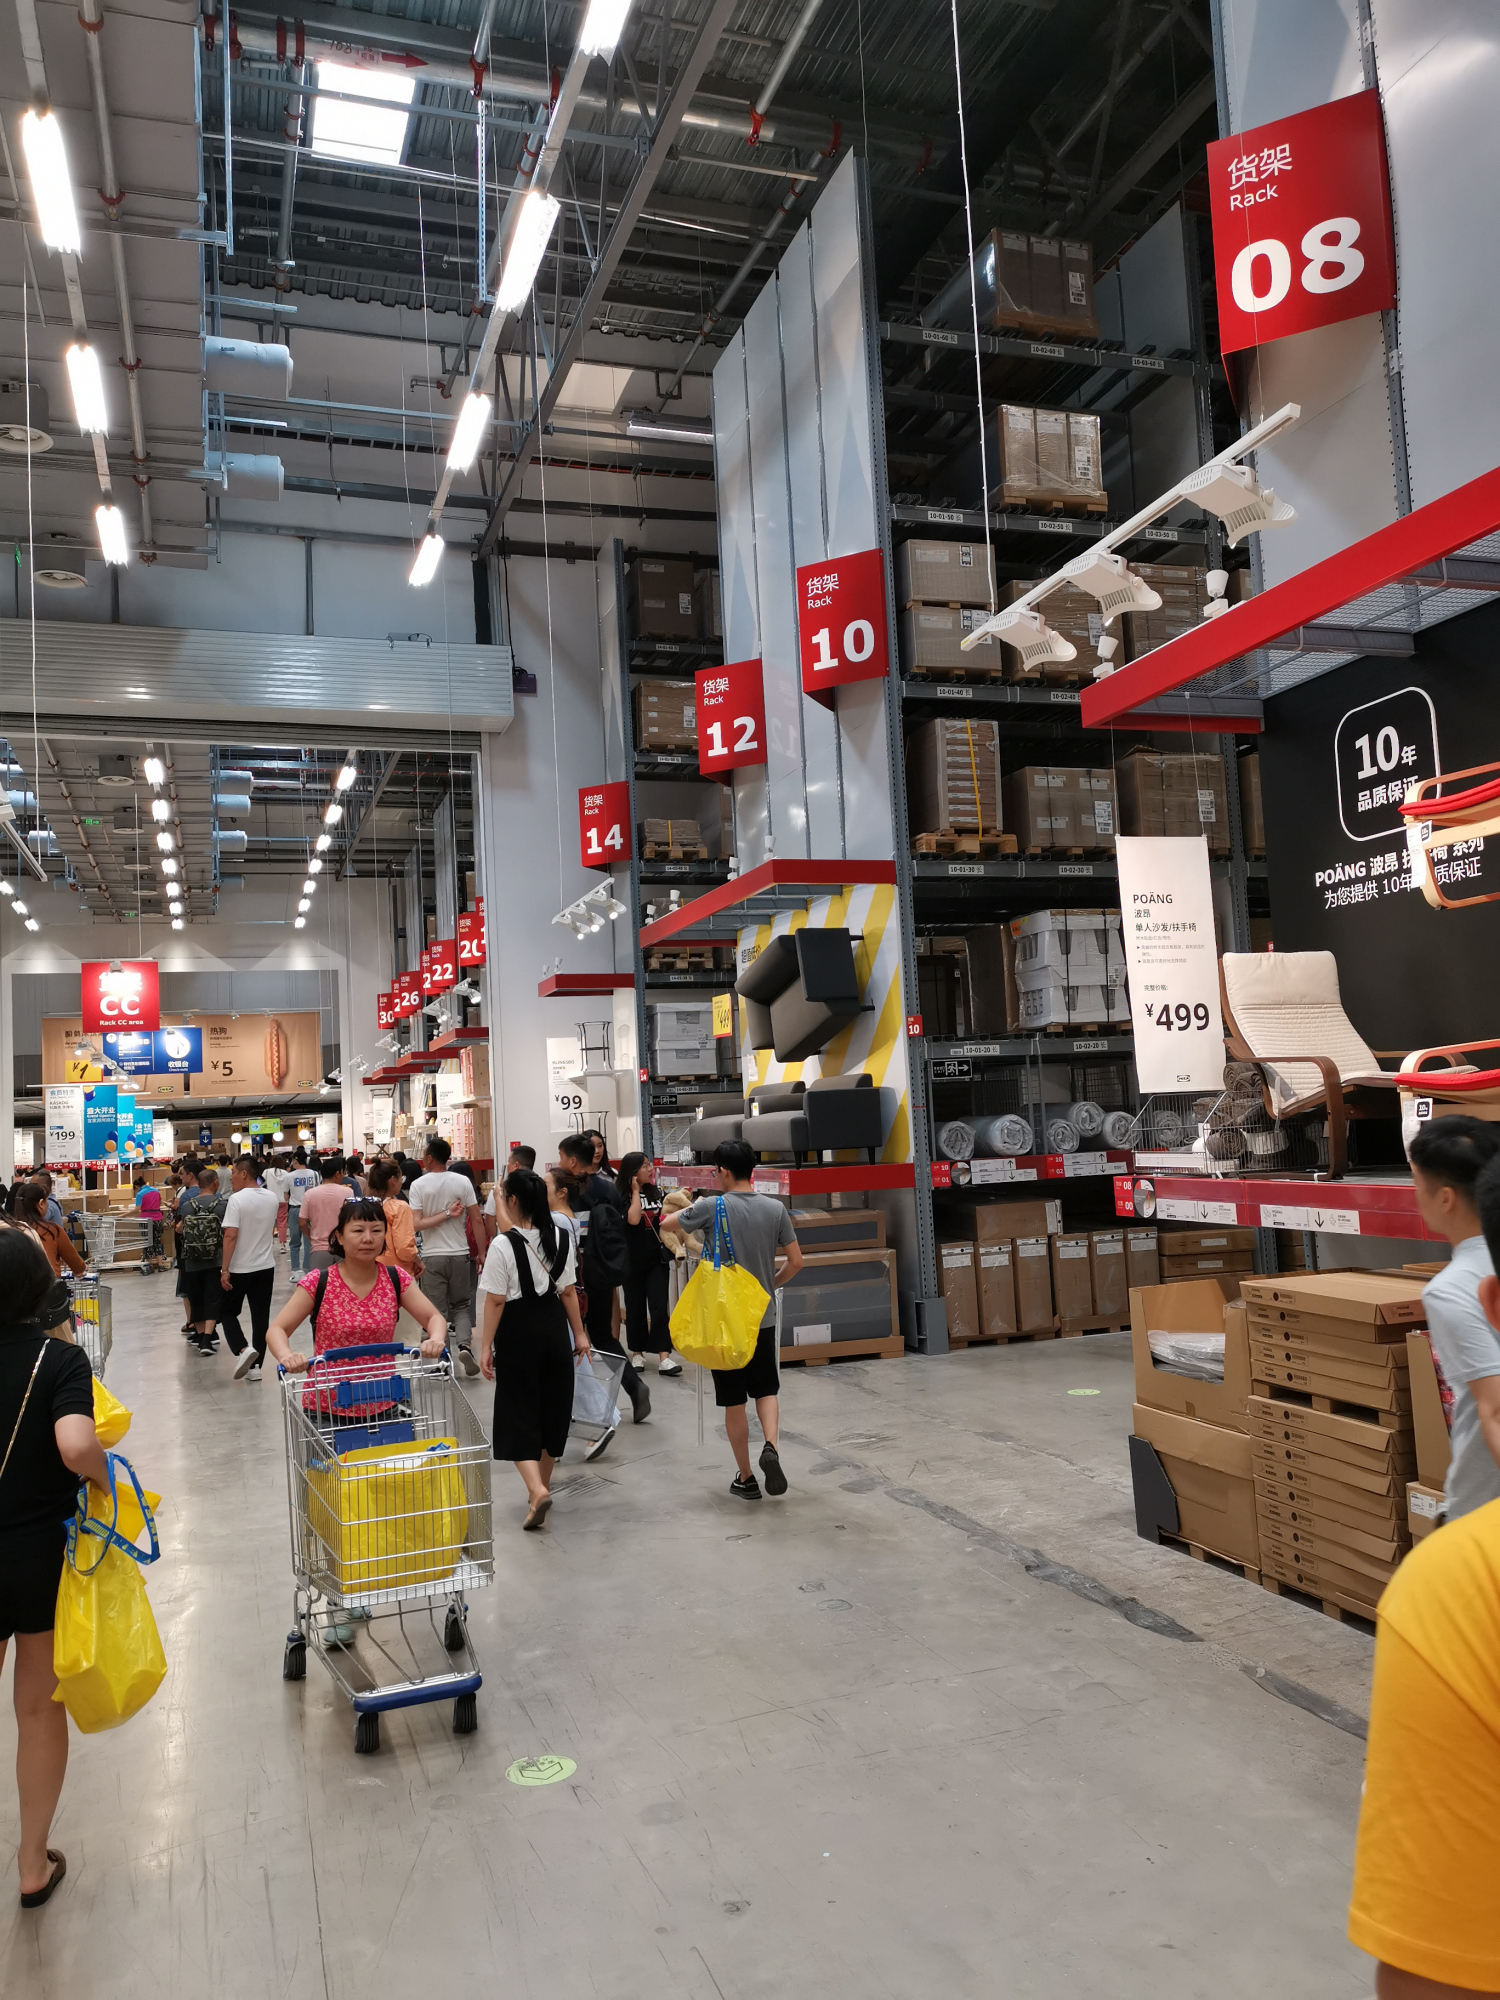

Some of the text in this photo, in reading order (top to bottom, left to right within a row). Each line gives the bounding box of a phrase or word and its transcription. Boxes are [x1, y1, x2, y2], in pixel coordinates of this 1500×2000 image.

[1227, 143, 1293, 190] 货架
[1230, 184, 1279, 212] Rack
[1231, 217, 1365, 313] 08
[930, 513, 954, 521] 10-01-50
[806, 573, 840, 597] 货架
[807, 595, 832, 609] Rack
[811, 619, 875, 671] 10
[703, 677, 730, 696] 货架
[703, 695, 724, 706] Rack
[706, 716, 758, 757] 12
[1355, 725, 1418, 780] 10年
[584, 794, 604, 807] 货架
[584, 807, 599, 816] Rack
[586, 824, 623, 854] 14
[1315, 861, 1367, 888] POÄNG
[1369, 852, 1399, 876] 波昂
[1133, 892, 1173, 904] POÄNG
[1324, 879, 1379, 909] 为您提供
[1134, 909, 1151, 918] 波昂
[1135, 922, 1197, 932] 单人沙发/扶手椅
[432, 963, 454, 981] 22
[100, 995, 140, 1016] CC
[401, 990, 419, 1006] 26
[379, 1011, 395, 1024] 30
[1145, 1002, 1210, 1032] ¥499
[209, 1027, 228, 1036] 热狗
[908, 1024, 920, 1035] 10
[211, 1060, 234, 1077] ¥5
[554, 1094, 583, 1110] ¥99
[49, 1131, 76, 1140] ¥199
[1123, 1181, 1132, 1190] 08
[1125, 1201, 1133, 1210] 00
